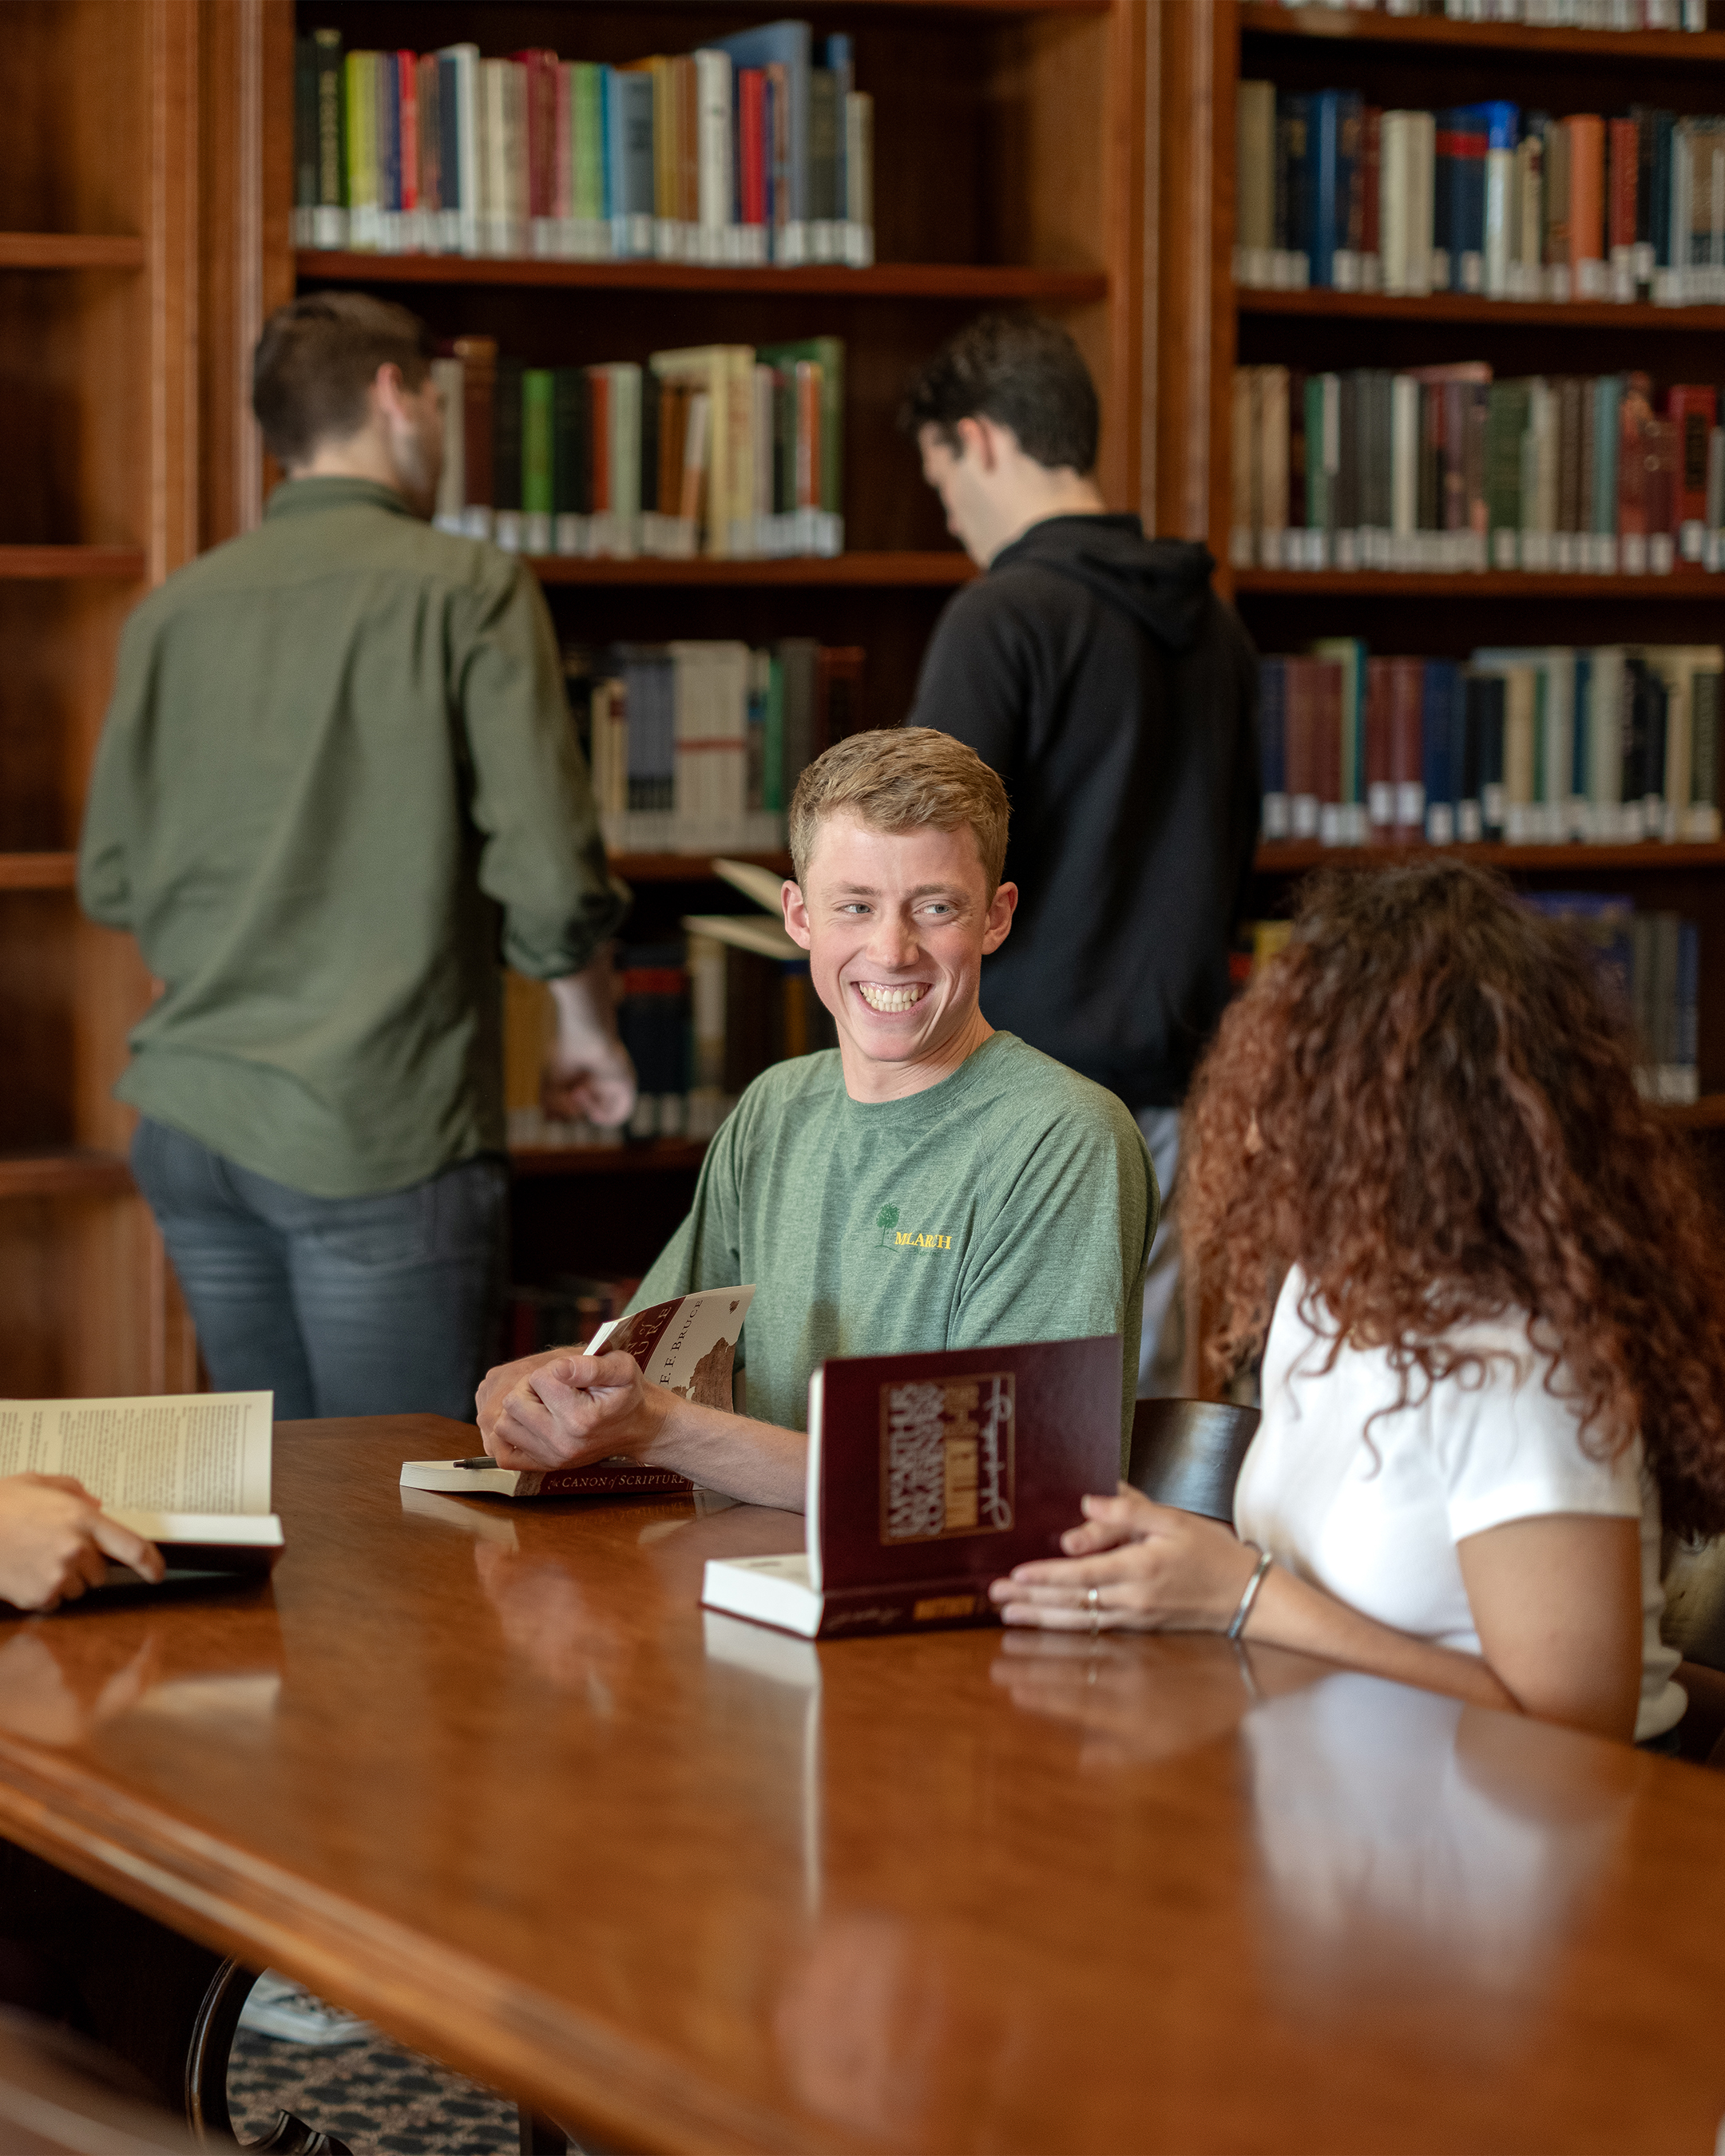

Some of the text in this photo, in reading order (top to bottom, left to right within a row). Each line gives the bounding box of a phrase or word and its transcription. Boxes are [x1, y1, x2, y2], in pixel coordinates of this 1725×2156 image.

[659, 1300, 703, 1385] F. F. BRUCE
[561, 1476, 608, 1488] CANON
[608, 1474, 620, 1490] of
[618, 1474, 685, 1485] SCRIPTURE
